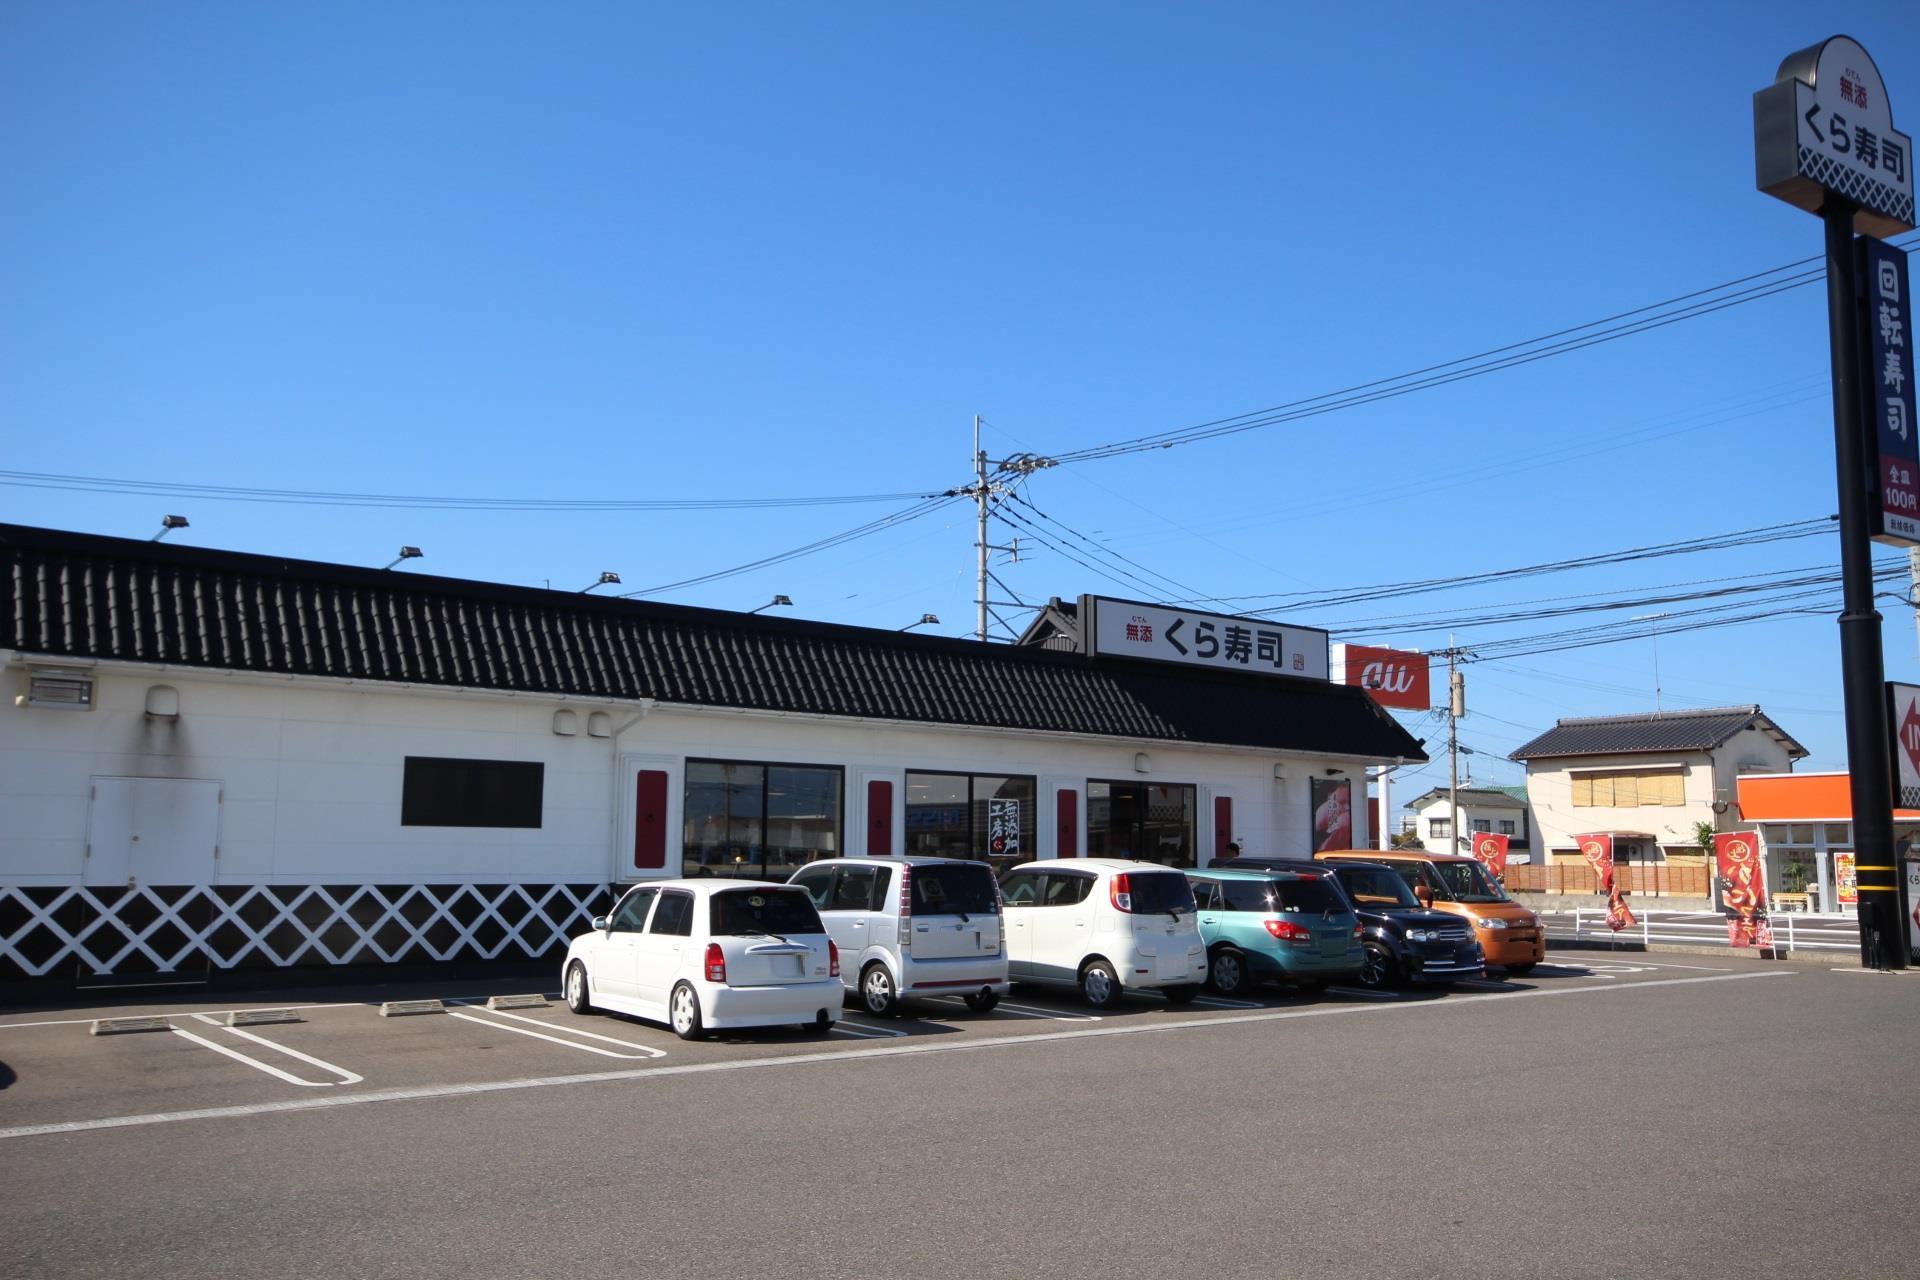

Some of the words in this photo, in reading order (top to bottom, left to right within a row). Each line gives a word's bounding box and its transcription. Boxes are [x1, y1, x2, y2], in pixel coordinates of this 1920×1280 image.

[1840, 75, 1867, 110] 無添
[1805, 103, 1904, 183] くら寿司
[1879, 258, 1907, 440] 回転寿司
[1886, 487, 1917, 511] 100円
[1126, 623, 1152, 642] 無添
[1165, 617, 1282, 668] くら寿司
[1361, 662, 1415, 693] au
[990, 804, 1003, 840] 工房
[1003, 800, 1018, 853] 無添加
